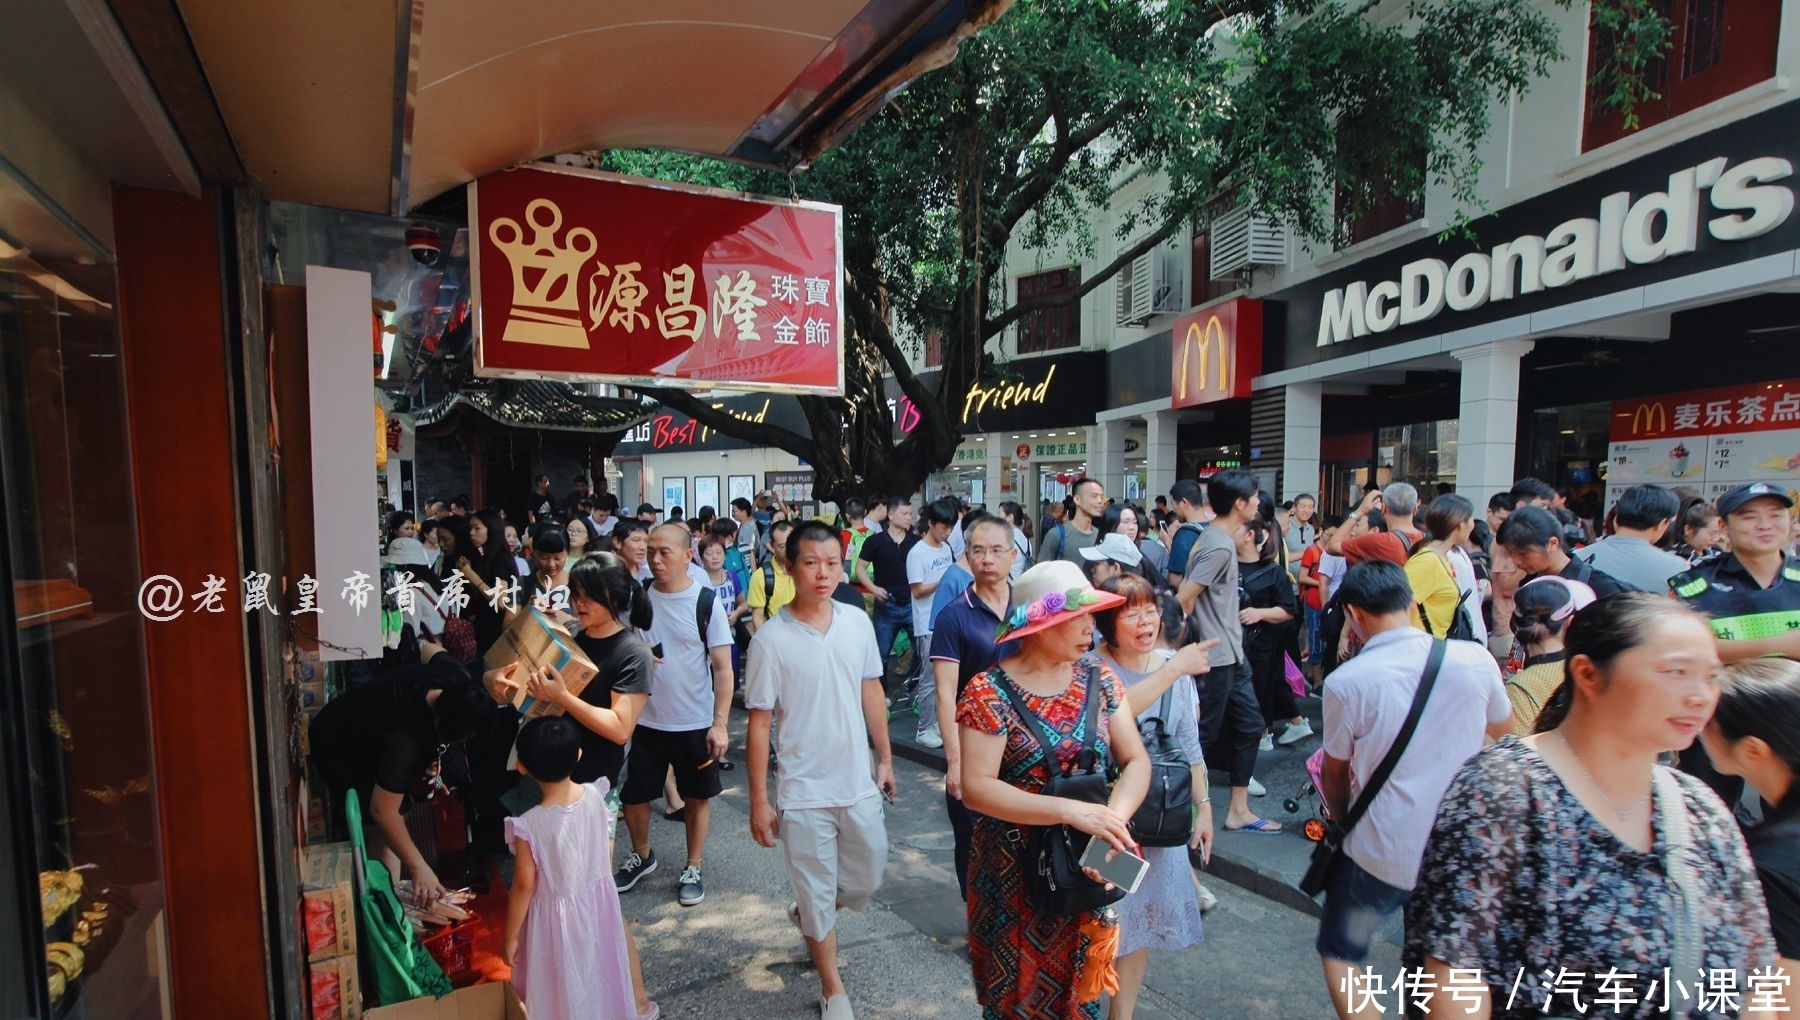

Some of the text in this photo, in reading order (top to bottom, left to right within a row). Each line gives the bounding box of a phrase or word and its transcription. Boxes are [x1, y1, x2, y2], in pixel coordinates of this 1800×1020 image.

[1316, 156, 1796, 348] McDonald's
[589, 261, 767, 342] 源昌隆
[771, 274, 830, 307] 珠寶
[772, 316, 831, 347] 金飾
[1673, 391, 1800, 431] 麦乐茶点
